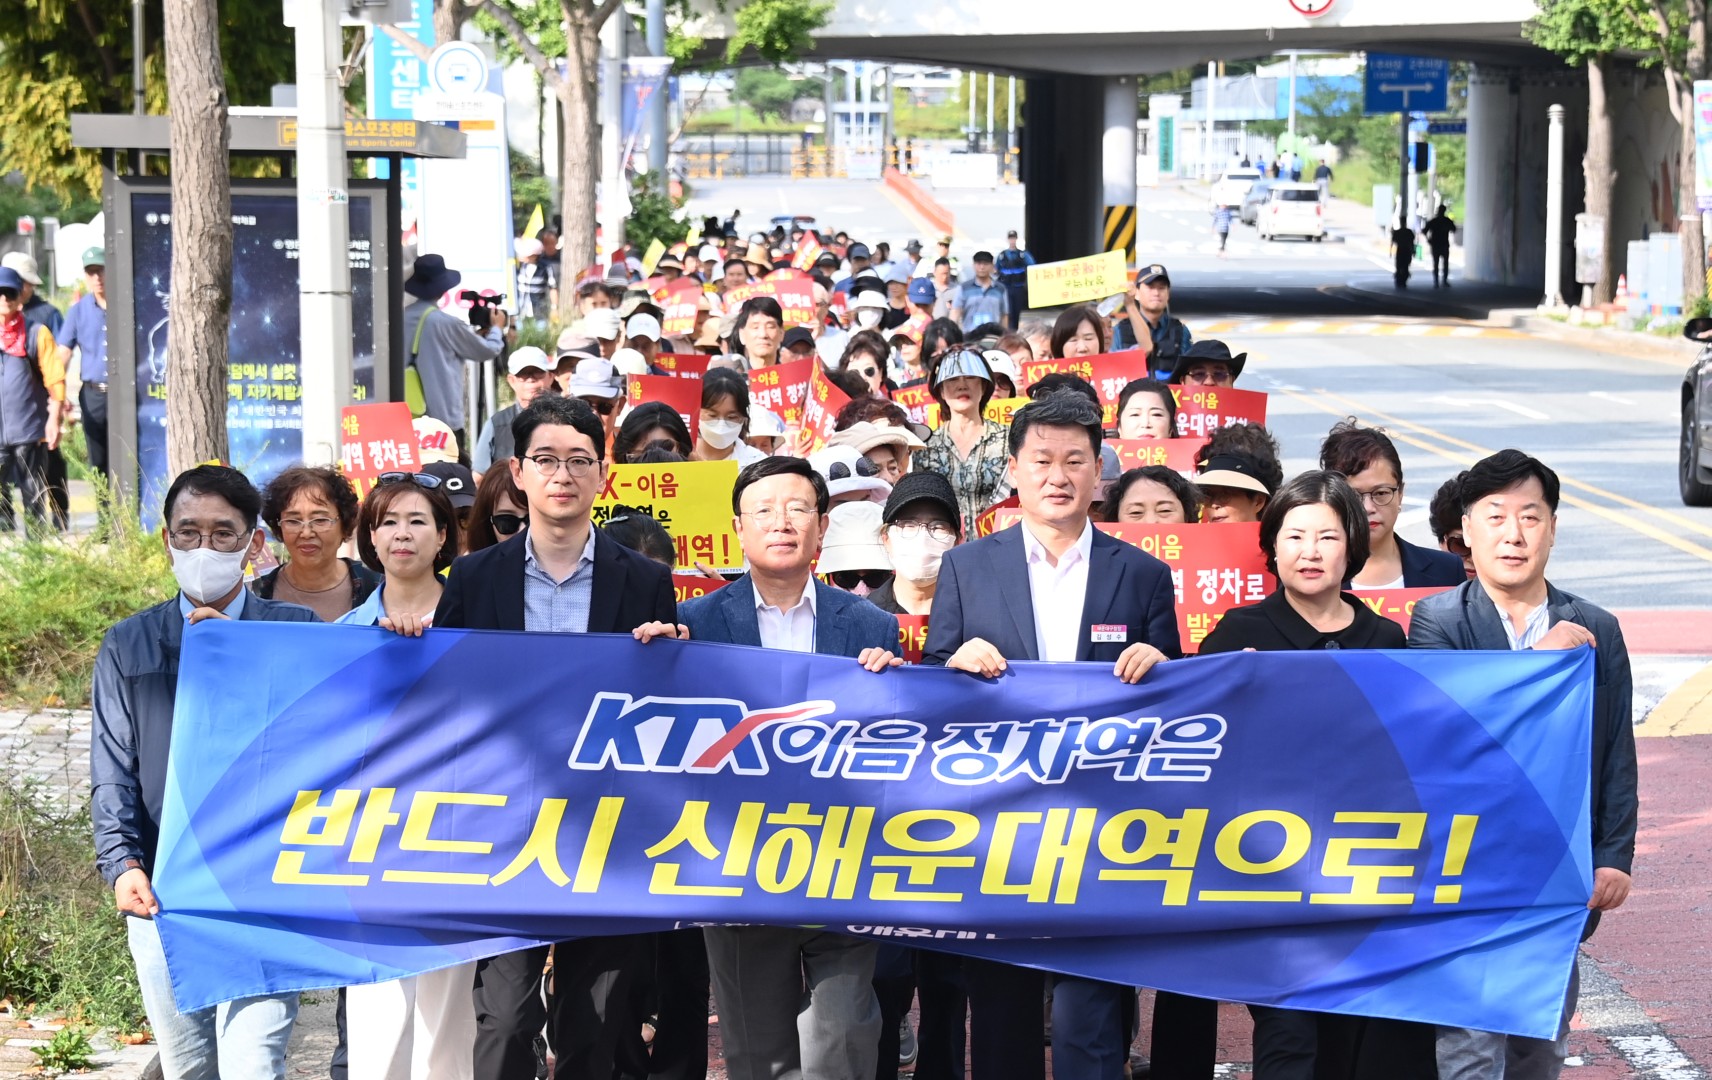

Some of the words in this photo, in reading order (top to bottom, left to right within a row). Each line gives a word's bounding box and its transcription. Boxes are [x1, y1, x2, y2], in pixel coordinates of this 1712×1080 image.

[361, 139, 388, 148] Sports
[389, 139, 416, 147] Center
[229, 363, 268, 380] 덤에서
[368, 438, 414, 470] 정차로
[1196, 567, 1266, 605] 정차로
[930, 713, 1228, 786] 정차역은
[271, 787, 625, 894] 반드시
[643, 800, 1479, 907] 신해운대역으로!
